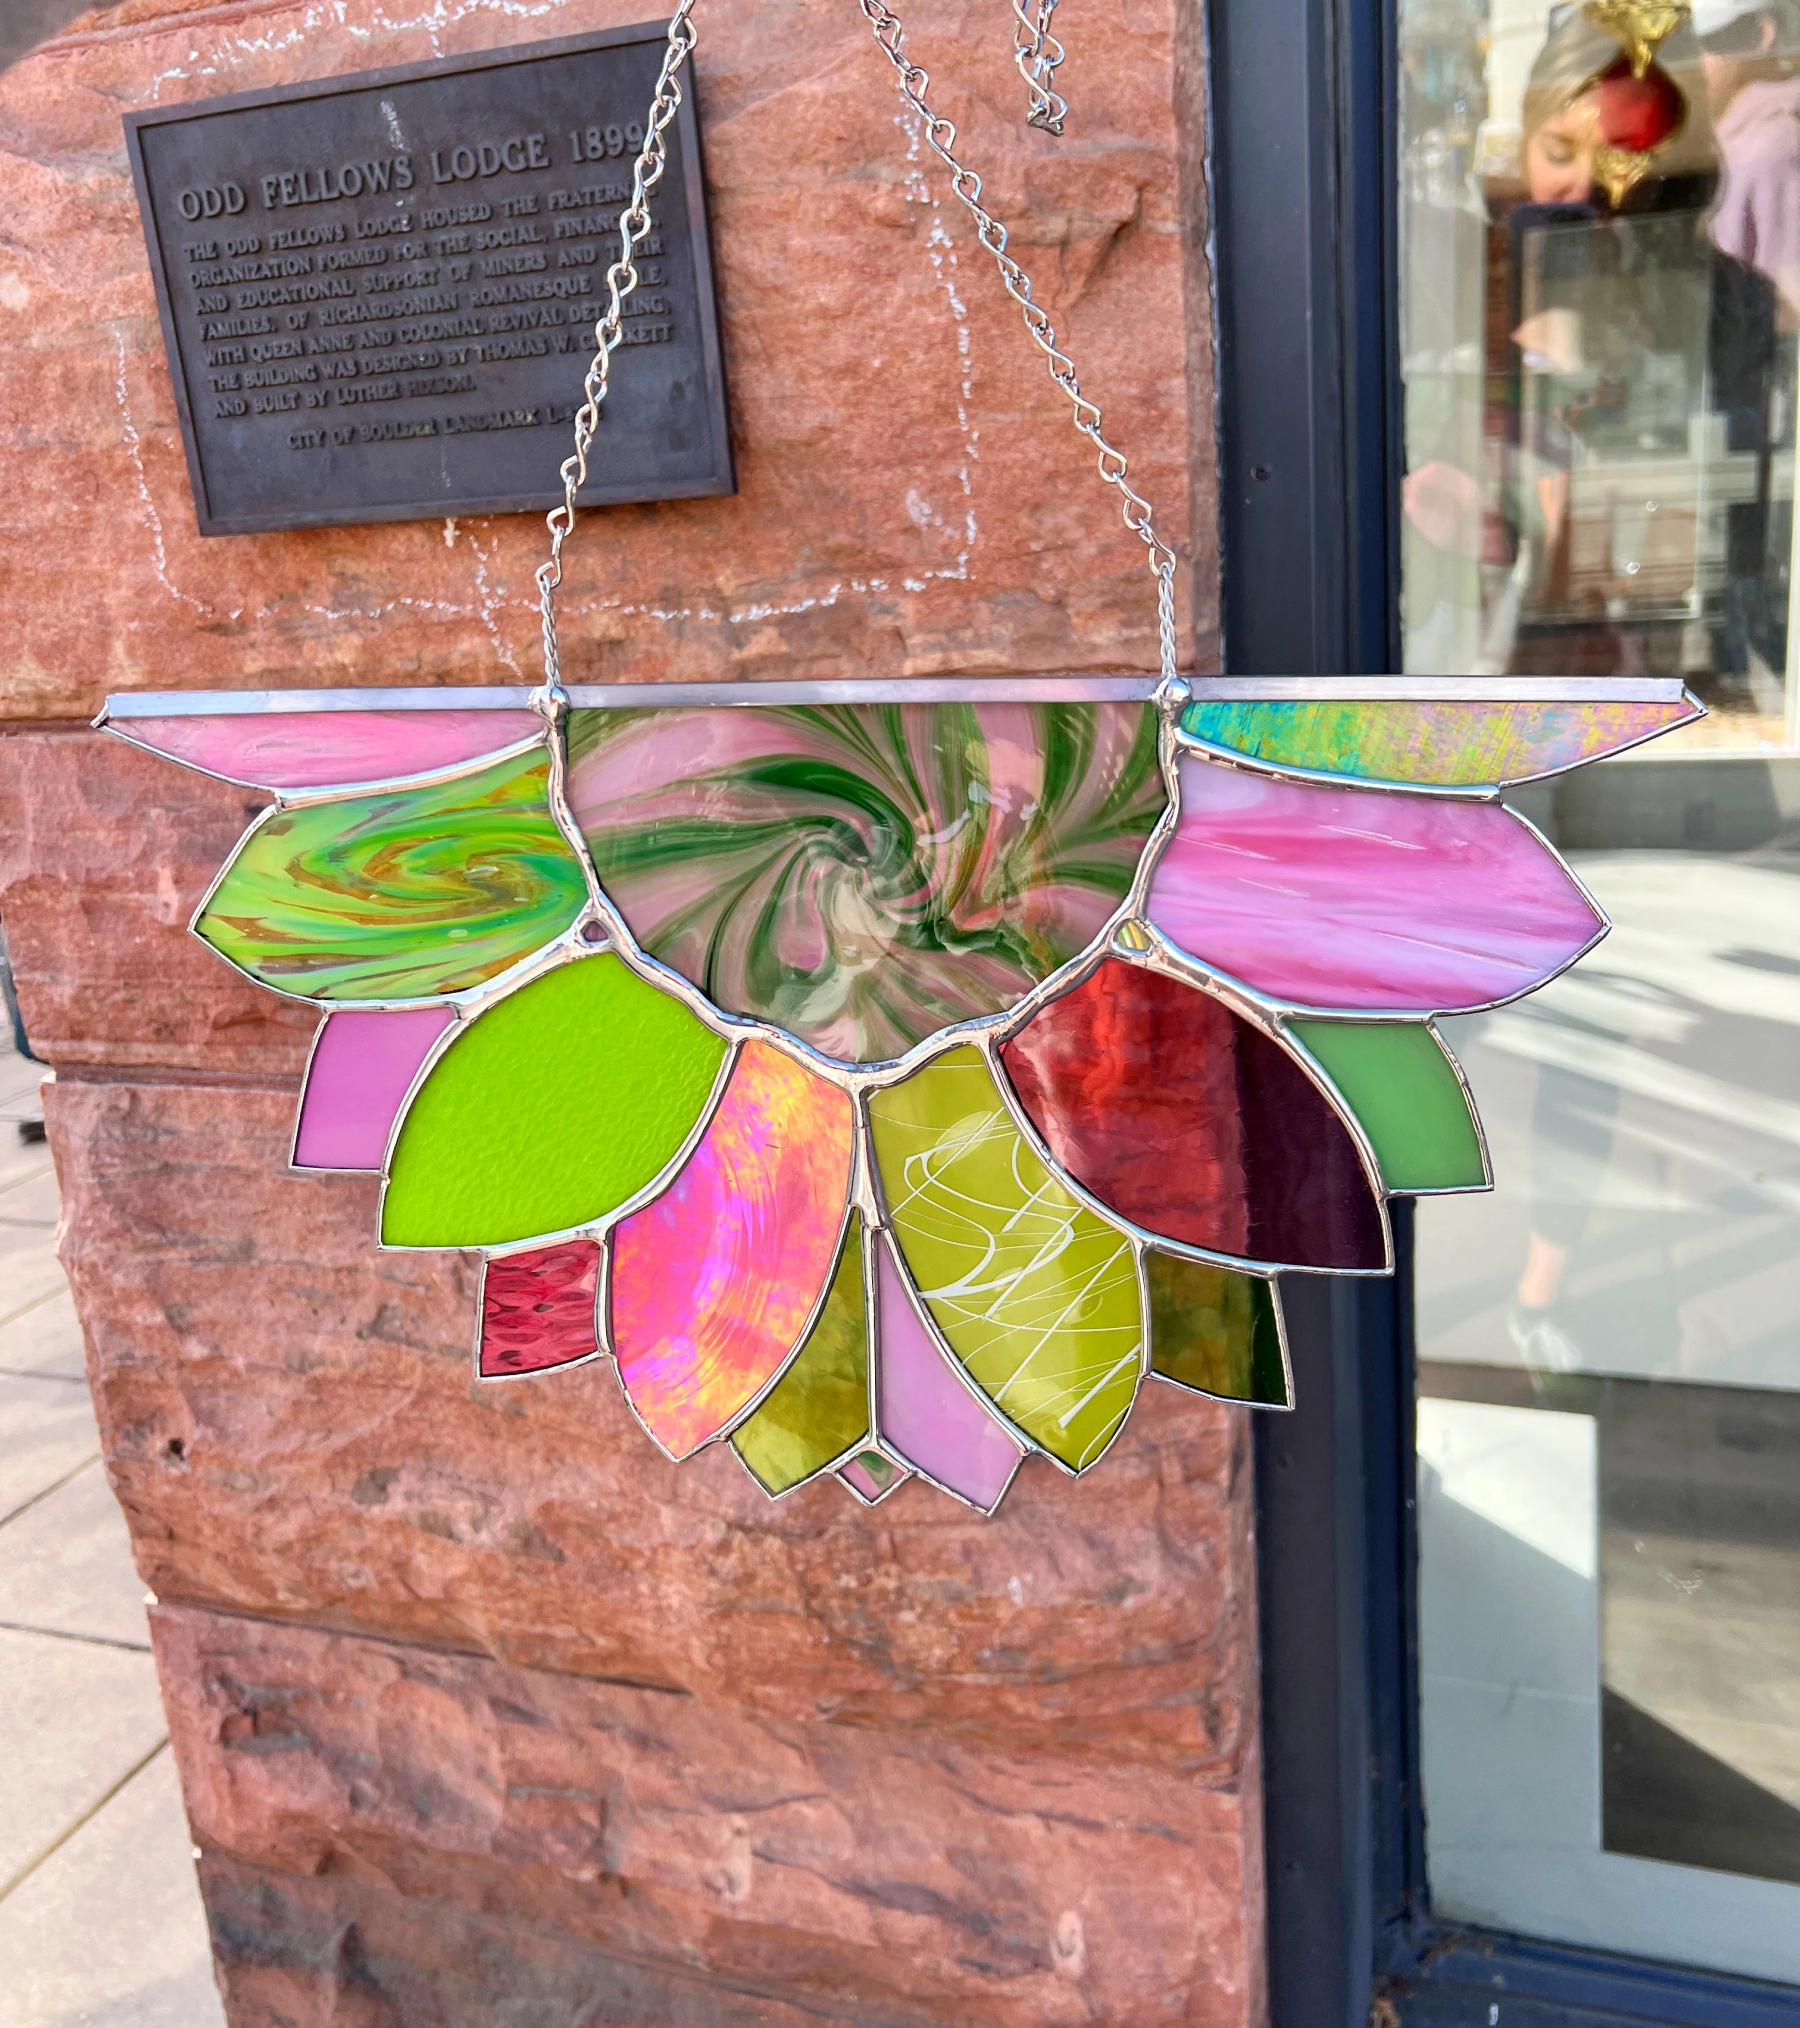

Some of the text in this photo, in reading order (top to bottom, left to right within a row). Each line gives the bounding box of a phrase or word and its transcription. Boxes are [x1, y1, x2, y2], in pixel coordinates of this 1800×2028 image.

[178, 122, 645, 220] ODD FELLOWS LODGE 1899
[184, 180, 659, 263] THE ODD FELLOWS LODGE HOUSED THE FRATERN
[189, 254, 312, 288] ORGANIZATION
[318, 248, 387, 271] FORMED
[393, 239, 427, 262] FOR
[431, 232, 470, 255] THE
[475, 224, 549, 250] SOCIAL,
[196, 237, 665, 315] AND EDUCATIONAL SUPPORT OF MINERS AND TEIR
[200, 315, 278, 341] FAMILIES.
[285, 309, 310, 330] OF
[319, 292, 459, 326] RICHARDSONIAN
[470, 277, 592, 308] ROMANESQUE
[204, 296, 671, 367] WITH QUEEN ANNE AND COLONIAL REVIVAL DETLING,
[208, 374, 241, 393] THE
[244, 364, 318, 389] BUILDING
[321, 359, 357, 379] WAS
[362, 352, 442, 376] DESIGNED
[447, 349, 467, 366] BY
[473, 339, 548, 363] THOMAS
[215, 400, 247, 419] AND
[253, 392, 300, 415] BUILT
[305, 390, 329, 409] BY
[336, 381, 400, 405] LUTHER
[287, 429, 326, 450] CITY
[331, 426, 356, 446] OF
[360, 418, 437, 443] BOULDER
[444, 408, 541, 436] LANDMARK
